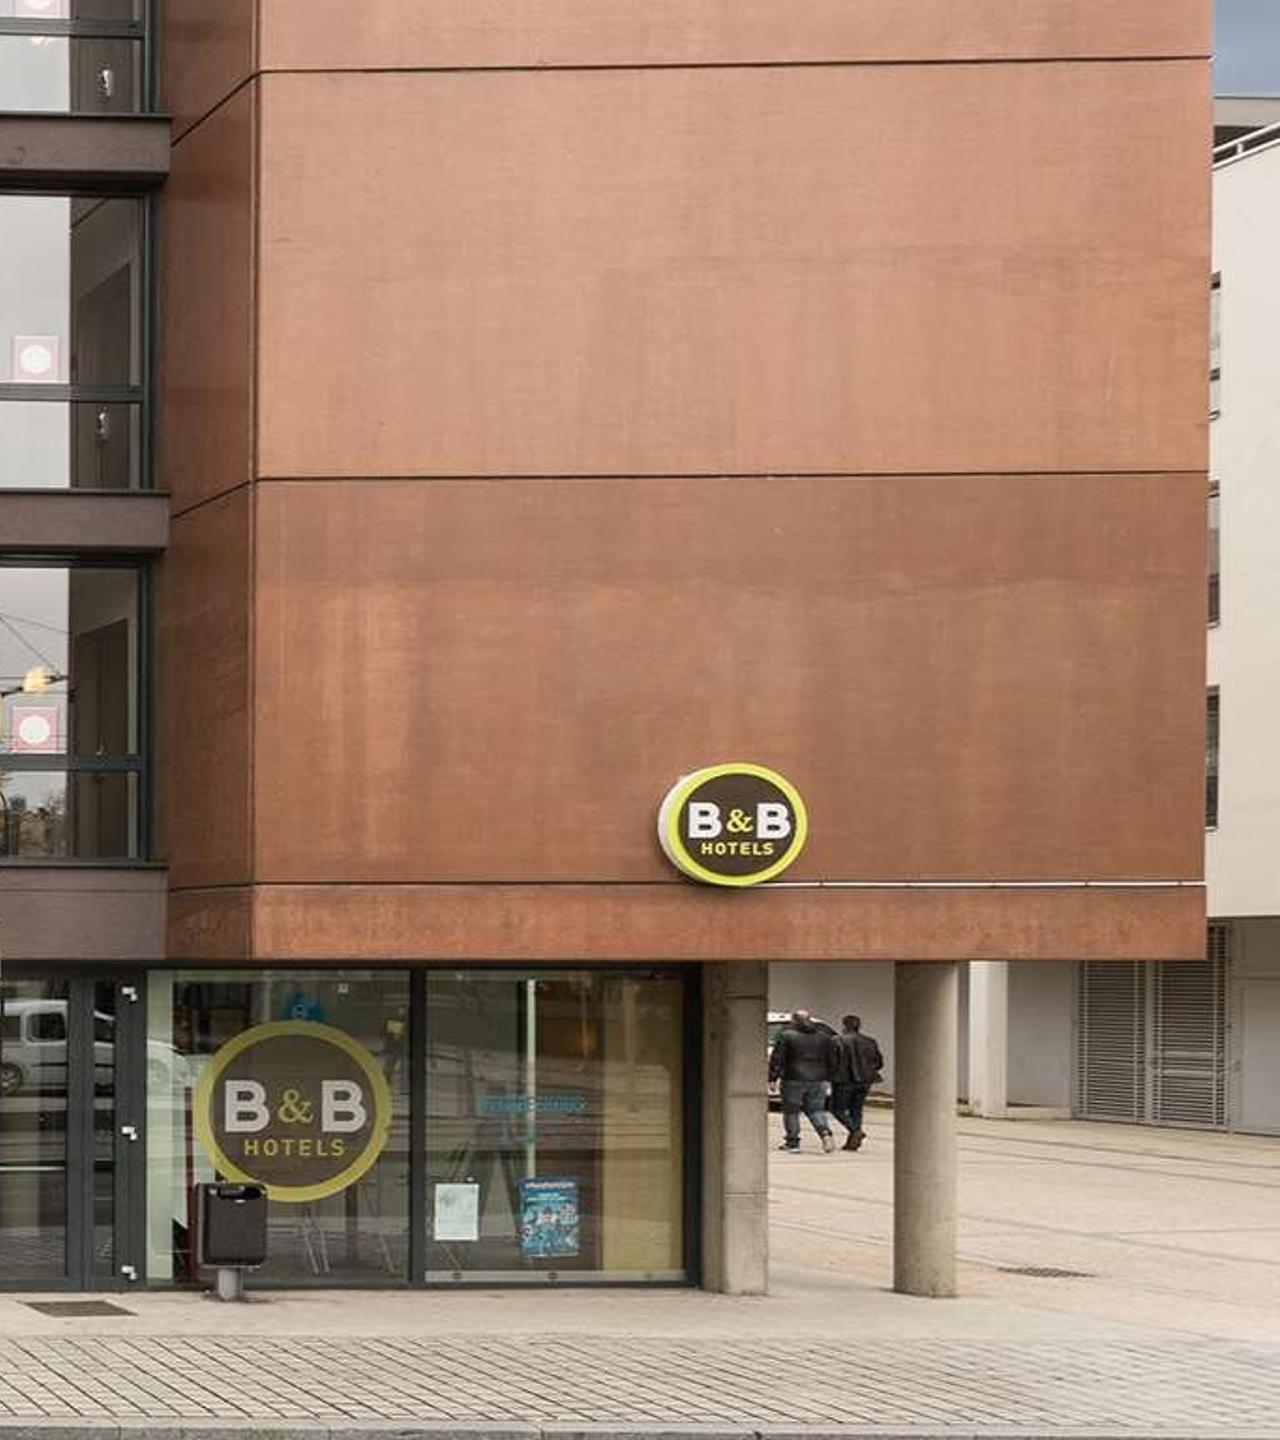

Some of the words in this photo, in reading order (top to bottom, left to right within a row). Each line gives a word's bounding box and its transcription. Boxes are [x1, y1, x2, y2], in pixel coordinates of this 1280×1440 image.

[688, 802, 790, 839] B&B
[701, 842, 774, 856] HOTELS
[225, 1080, 367, 1133] B&B
[244, 1139, 346, 1156] HOTELS
